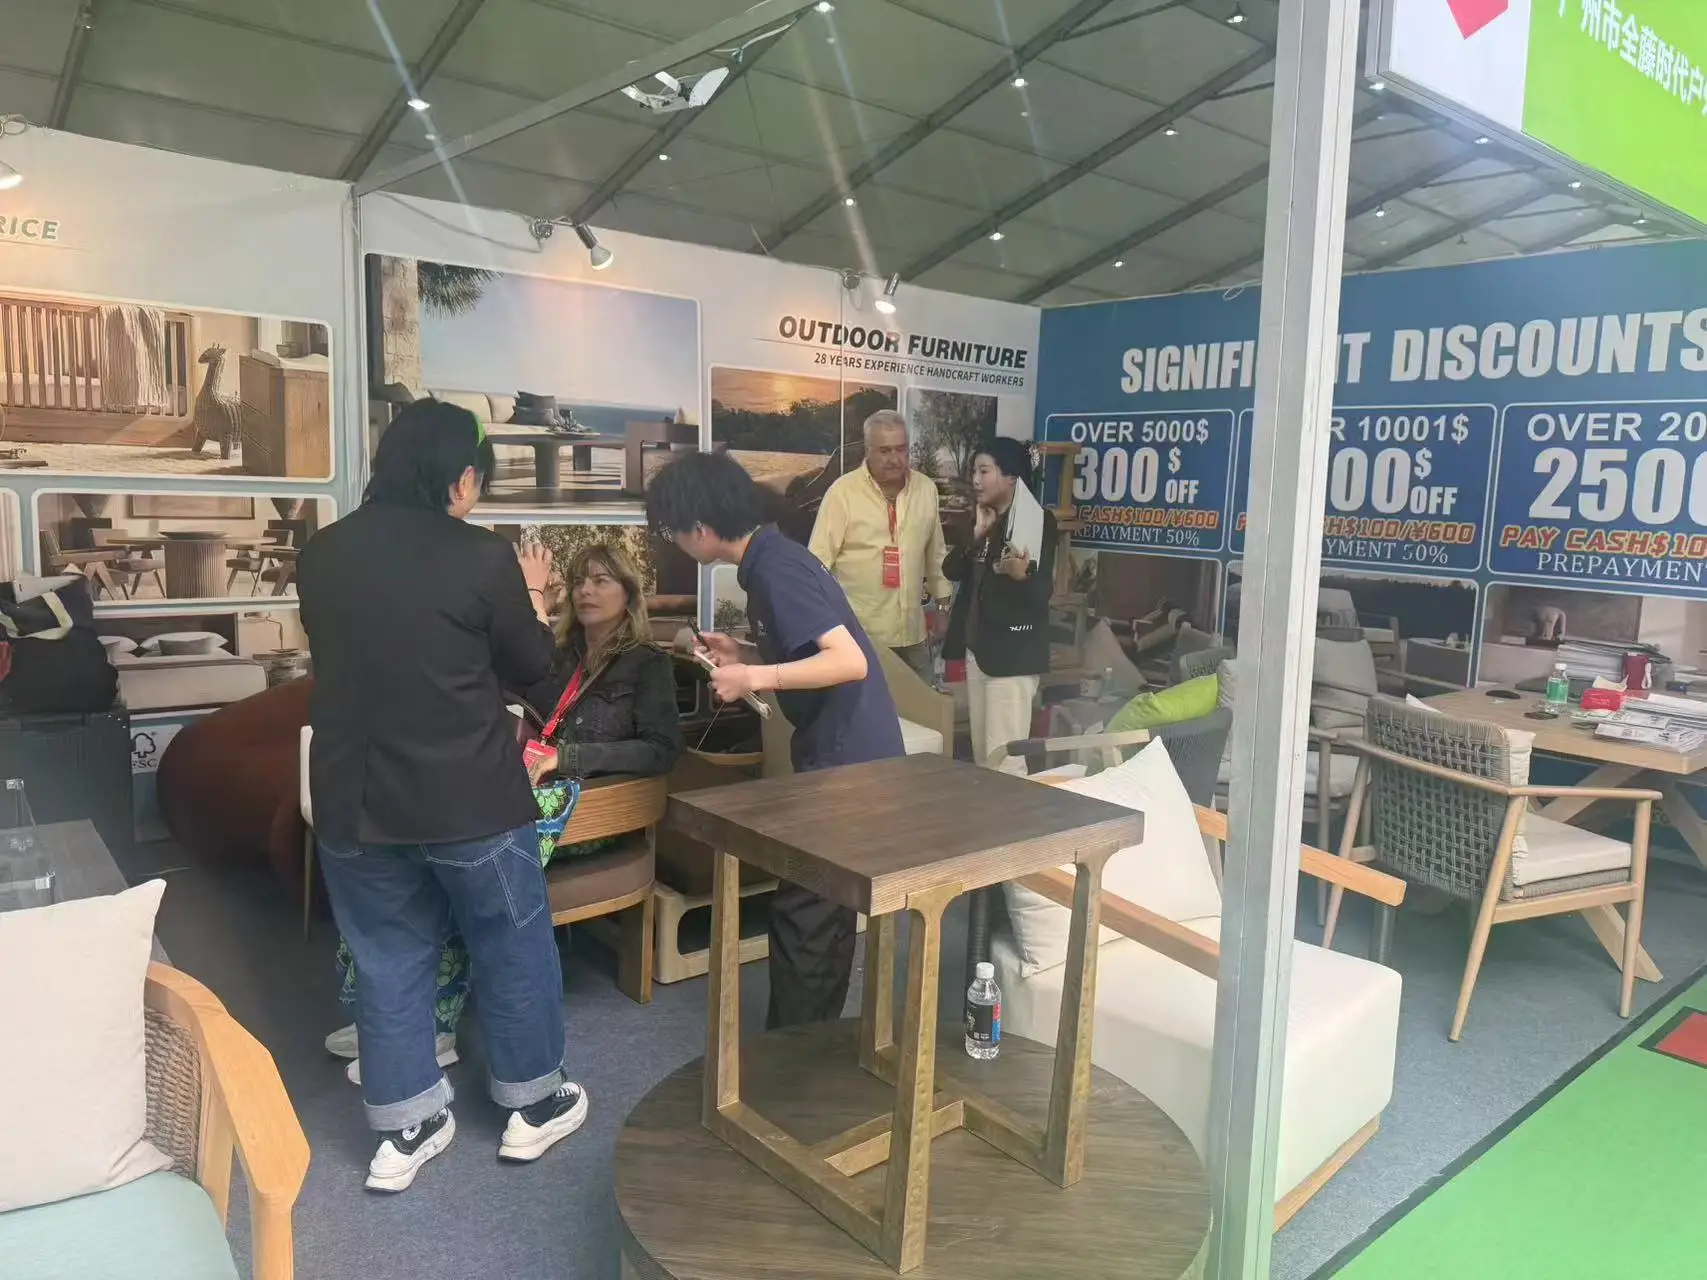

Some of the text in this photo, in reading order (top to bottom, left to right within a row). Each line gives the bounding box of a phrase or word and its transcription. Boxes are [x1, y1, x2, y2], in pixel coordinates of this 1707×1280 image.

[1558, 0, 1707, 116] 州市全藤时代户
[779, 315, 1028, 369] OUTDOOR FURNITURE
[1121, 308, 1707, 394] SIGNIFIT DISCOUNTS
[814, 352, 1025, 387] 28 YEARS EXPERIENCE HANDCRAFT WORKERS
[1071, 418, 1209, 445] OVER 5000$
[1359, 413, 1469, 444] 10001$
[1527, 412, 1642, 442] OVER
[1073, 446, 1182, 503] 300 $
[1330, 447, 1432, 514] 00 $
[1165, 479, 1200, 504] OFF
[1410, 486, 1458, 515] OFF
[1166, 530, 1200, 547] 50%
[1323, 515, 1476, 544] H$100/¥600
[1500, 524, 1560, 548] PAY
[1402, 543, 1448, 565] 50%
[1536, 552, 1707, 583] PREPAYMEN
